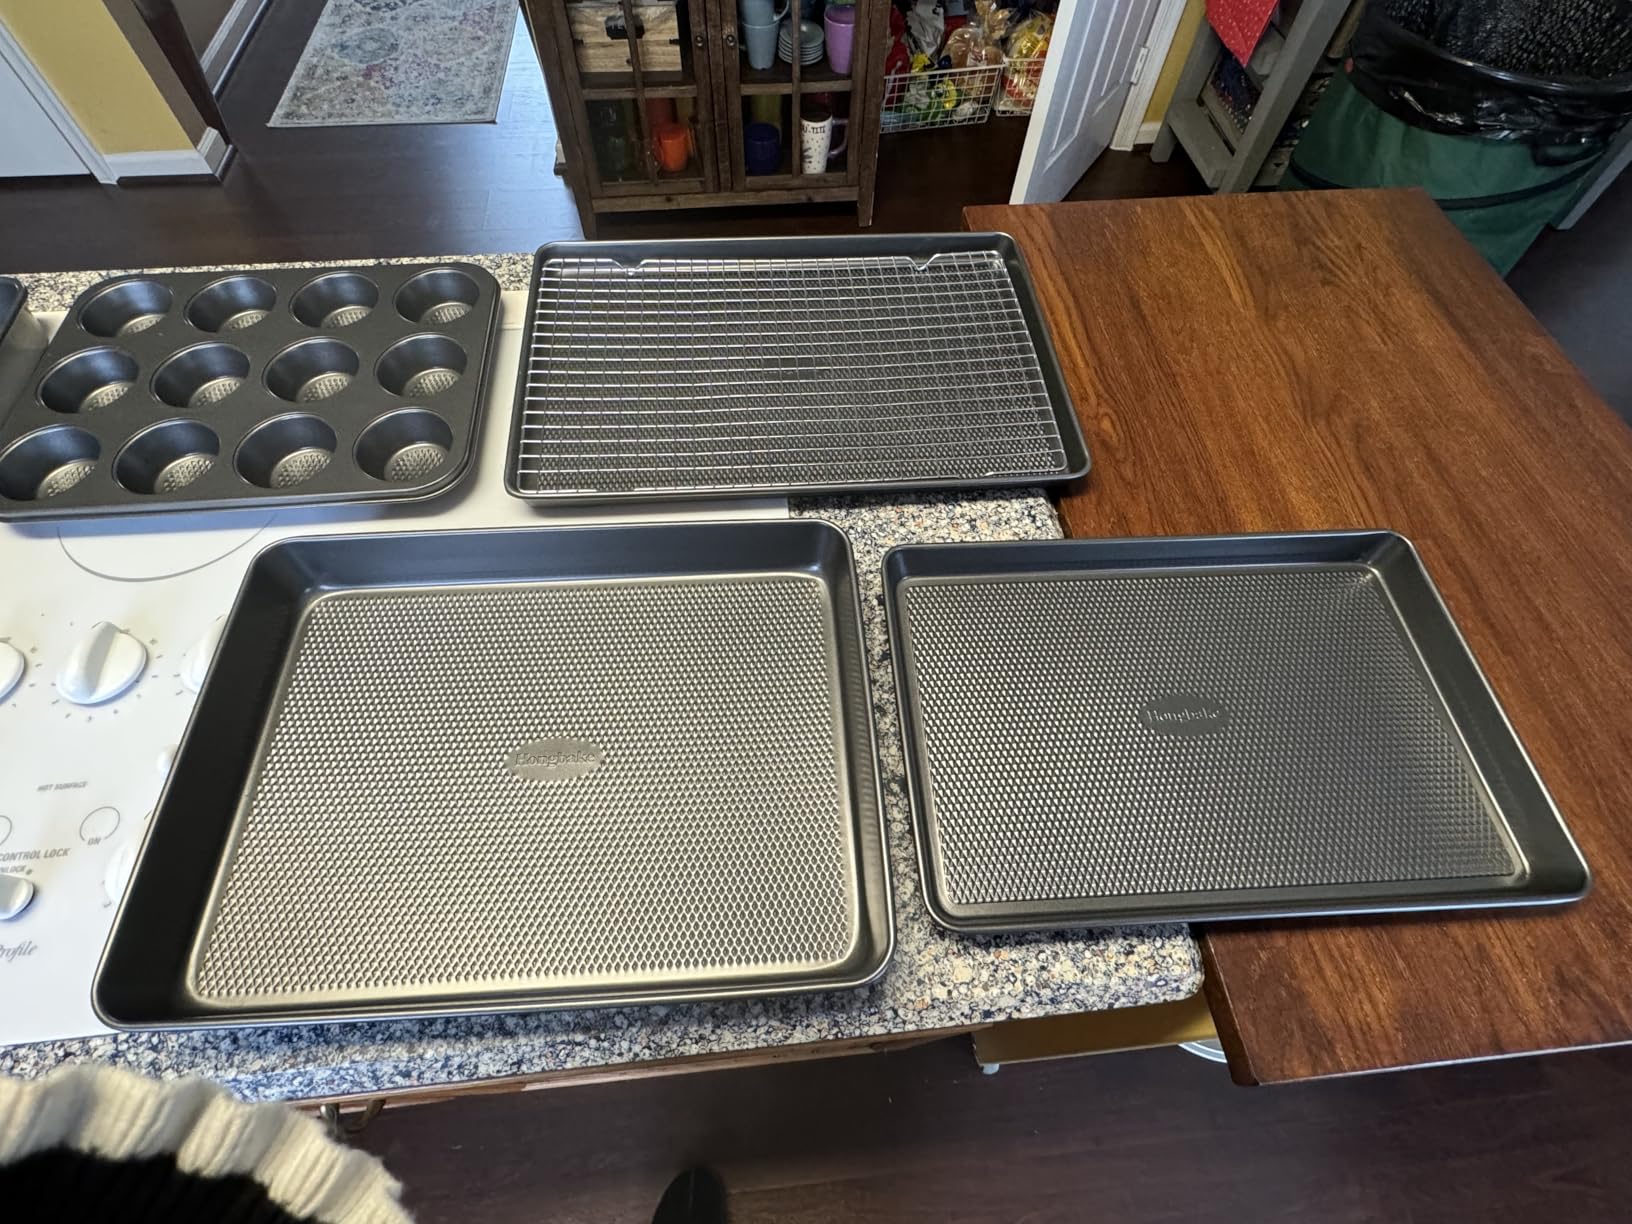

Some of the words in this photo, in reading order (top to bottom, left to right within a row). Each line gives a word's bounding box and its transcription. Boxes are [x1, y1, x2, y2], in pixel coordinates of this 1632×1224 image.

[514, 750, 596, 769] Hongbake
[88, 837, 102, 846] ON
[43, 848, 72, 859] LOCK
